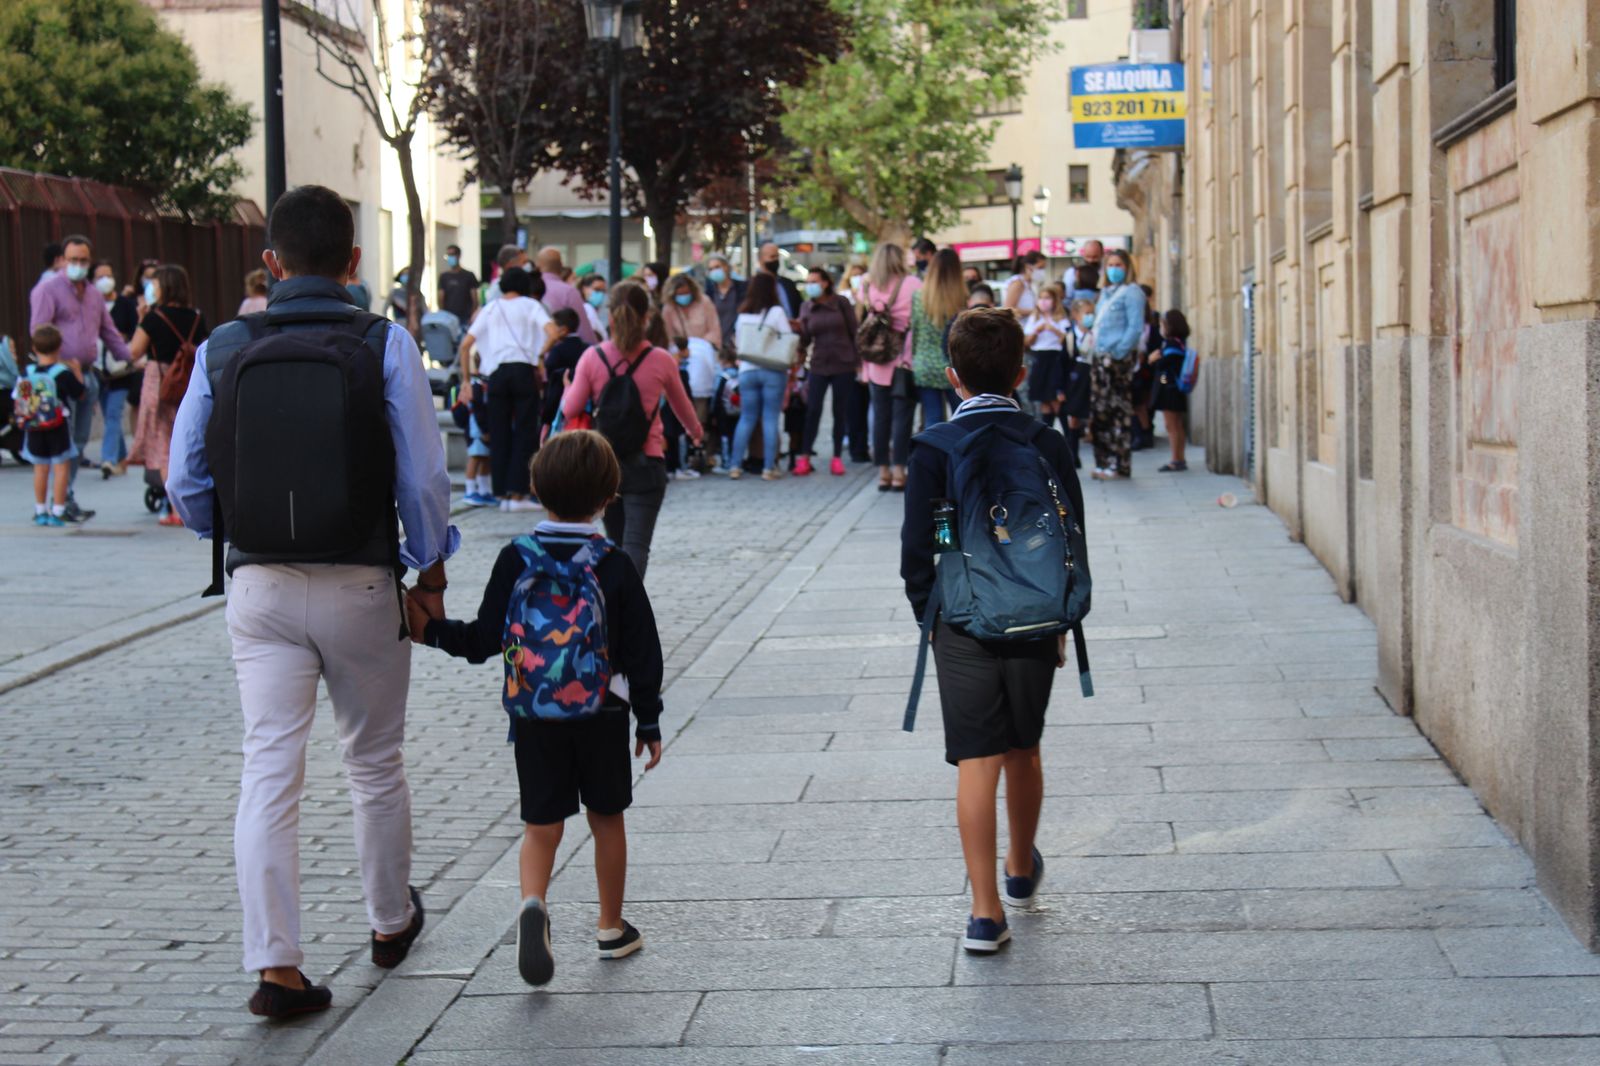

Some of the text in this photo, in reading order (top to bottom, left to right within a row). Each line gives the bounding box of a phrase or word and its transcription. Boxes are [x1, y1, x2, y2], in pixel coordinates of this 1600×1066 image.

[1083, 69, 1173, 92] SE ALQUILA
[1082, 98, 1176, 117] 923 201 711
